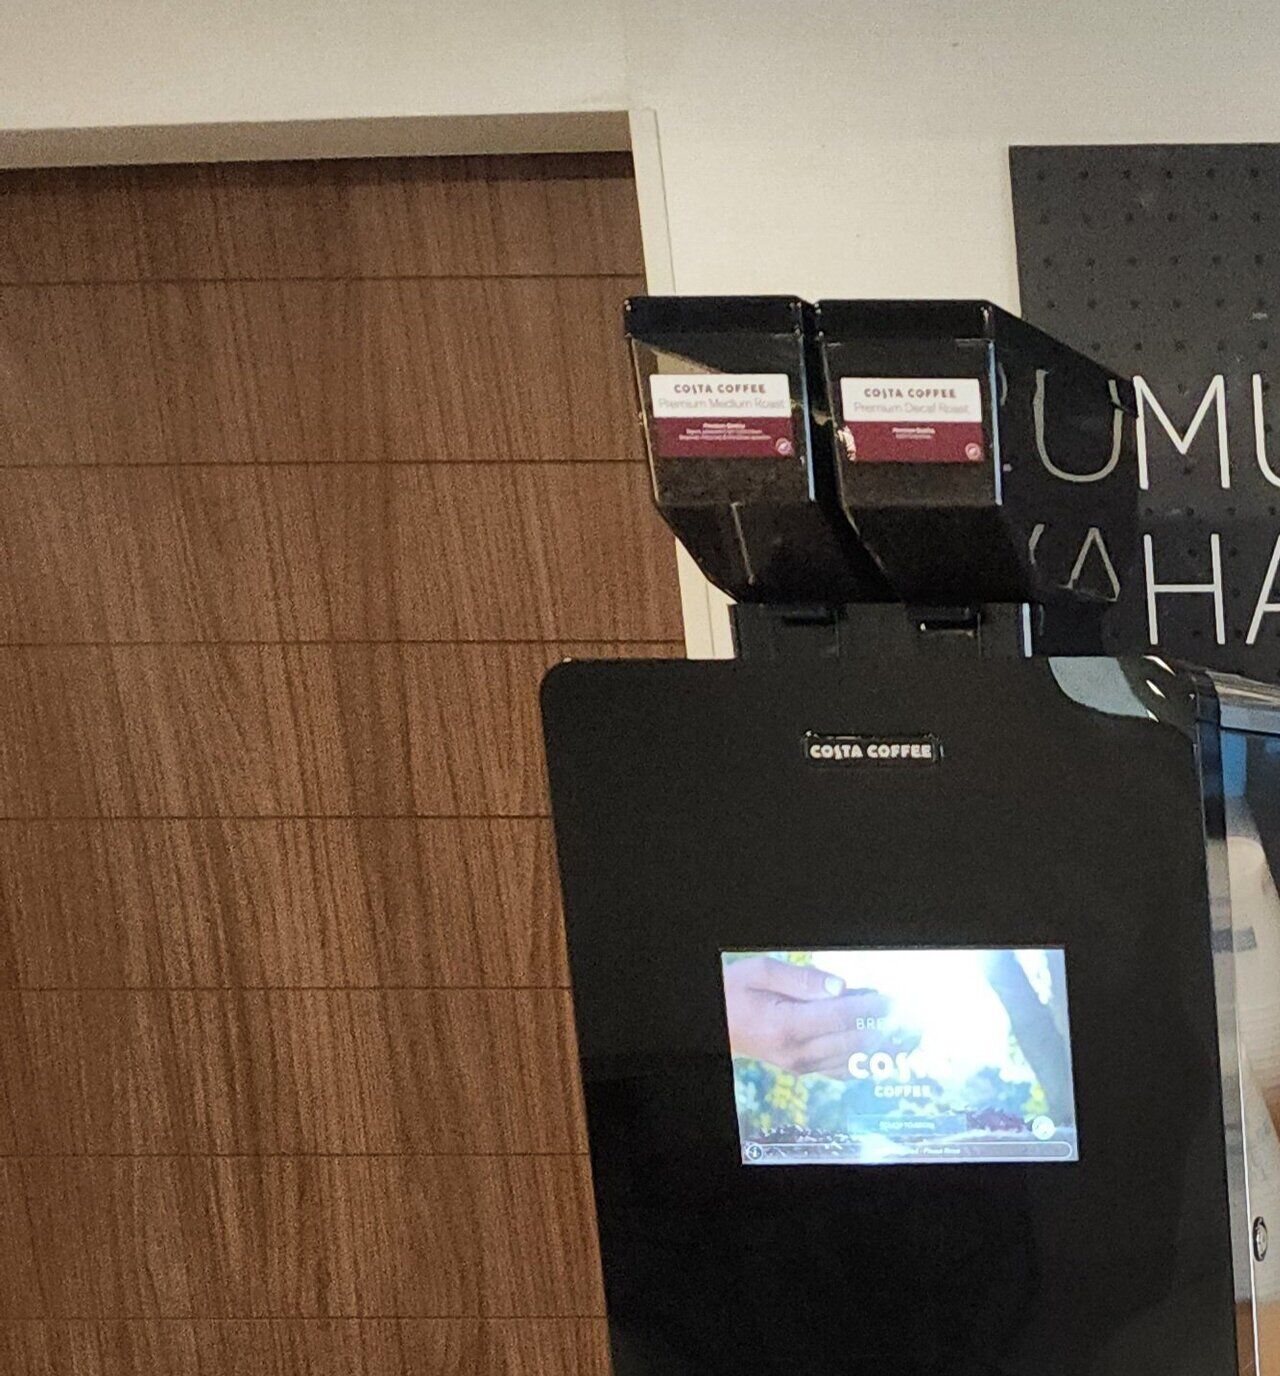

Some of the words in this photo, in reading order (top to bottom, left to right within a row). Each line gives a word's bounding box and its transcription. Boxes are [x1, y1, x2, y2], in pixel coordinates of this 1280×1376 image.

[674, 383, 713, 395] COSTA
[717, 383, 767, 394] COFFEE
[863, 387, 903, 399] COSTA
[907, 387, 957, 399] COFFEE
[809, 743, 863, 760] COSTA
[866, 744, 933, 759] COFFEE
